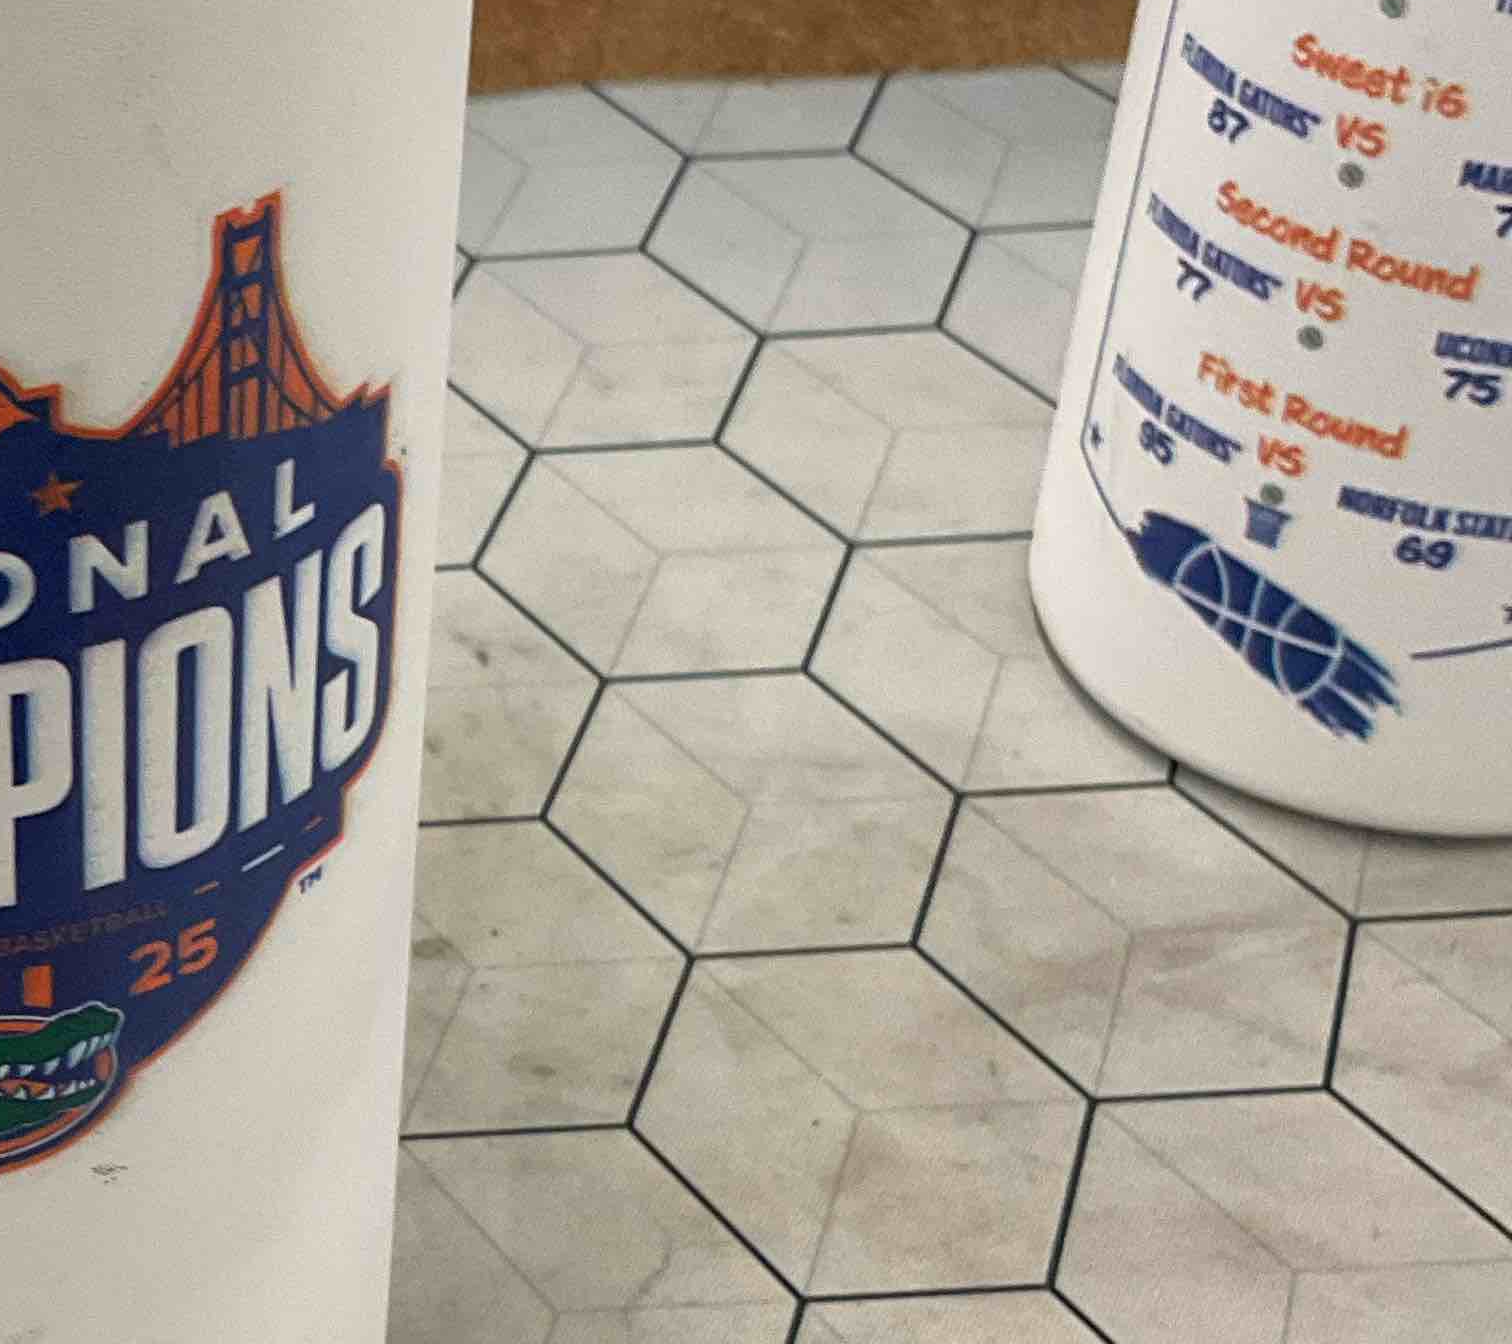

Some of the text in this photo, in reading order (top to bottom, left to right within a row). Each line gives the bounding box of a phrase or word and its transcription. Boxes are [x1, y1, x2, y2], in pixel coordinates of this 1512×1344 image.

[1293, 34, 1410, 105] Sweet
[1208, 99, 1249, 143] 87
[1217, 181, 1481, 303] Second Round
[1176, 258, 1502, 407] 77 75
[1197, 352, 1410, 460] First Round
[1140, 420, 1456, 571] 95 69
[1337, 485, 1450, 532] NORFOLK
[128, 919, 219, 995] 25
